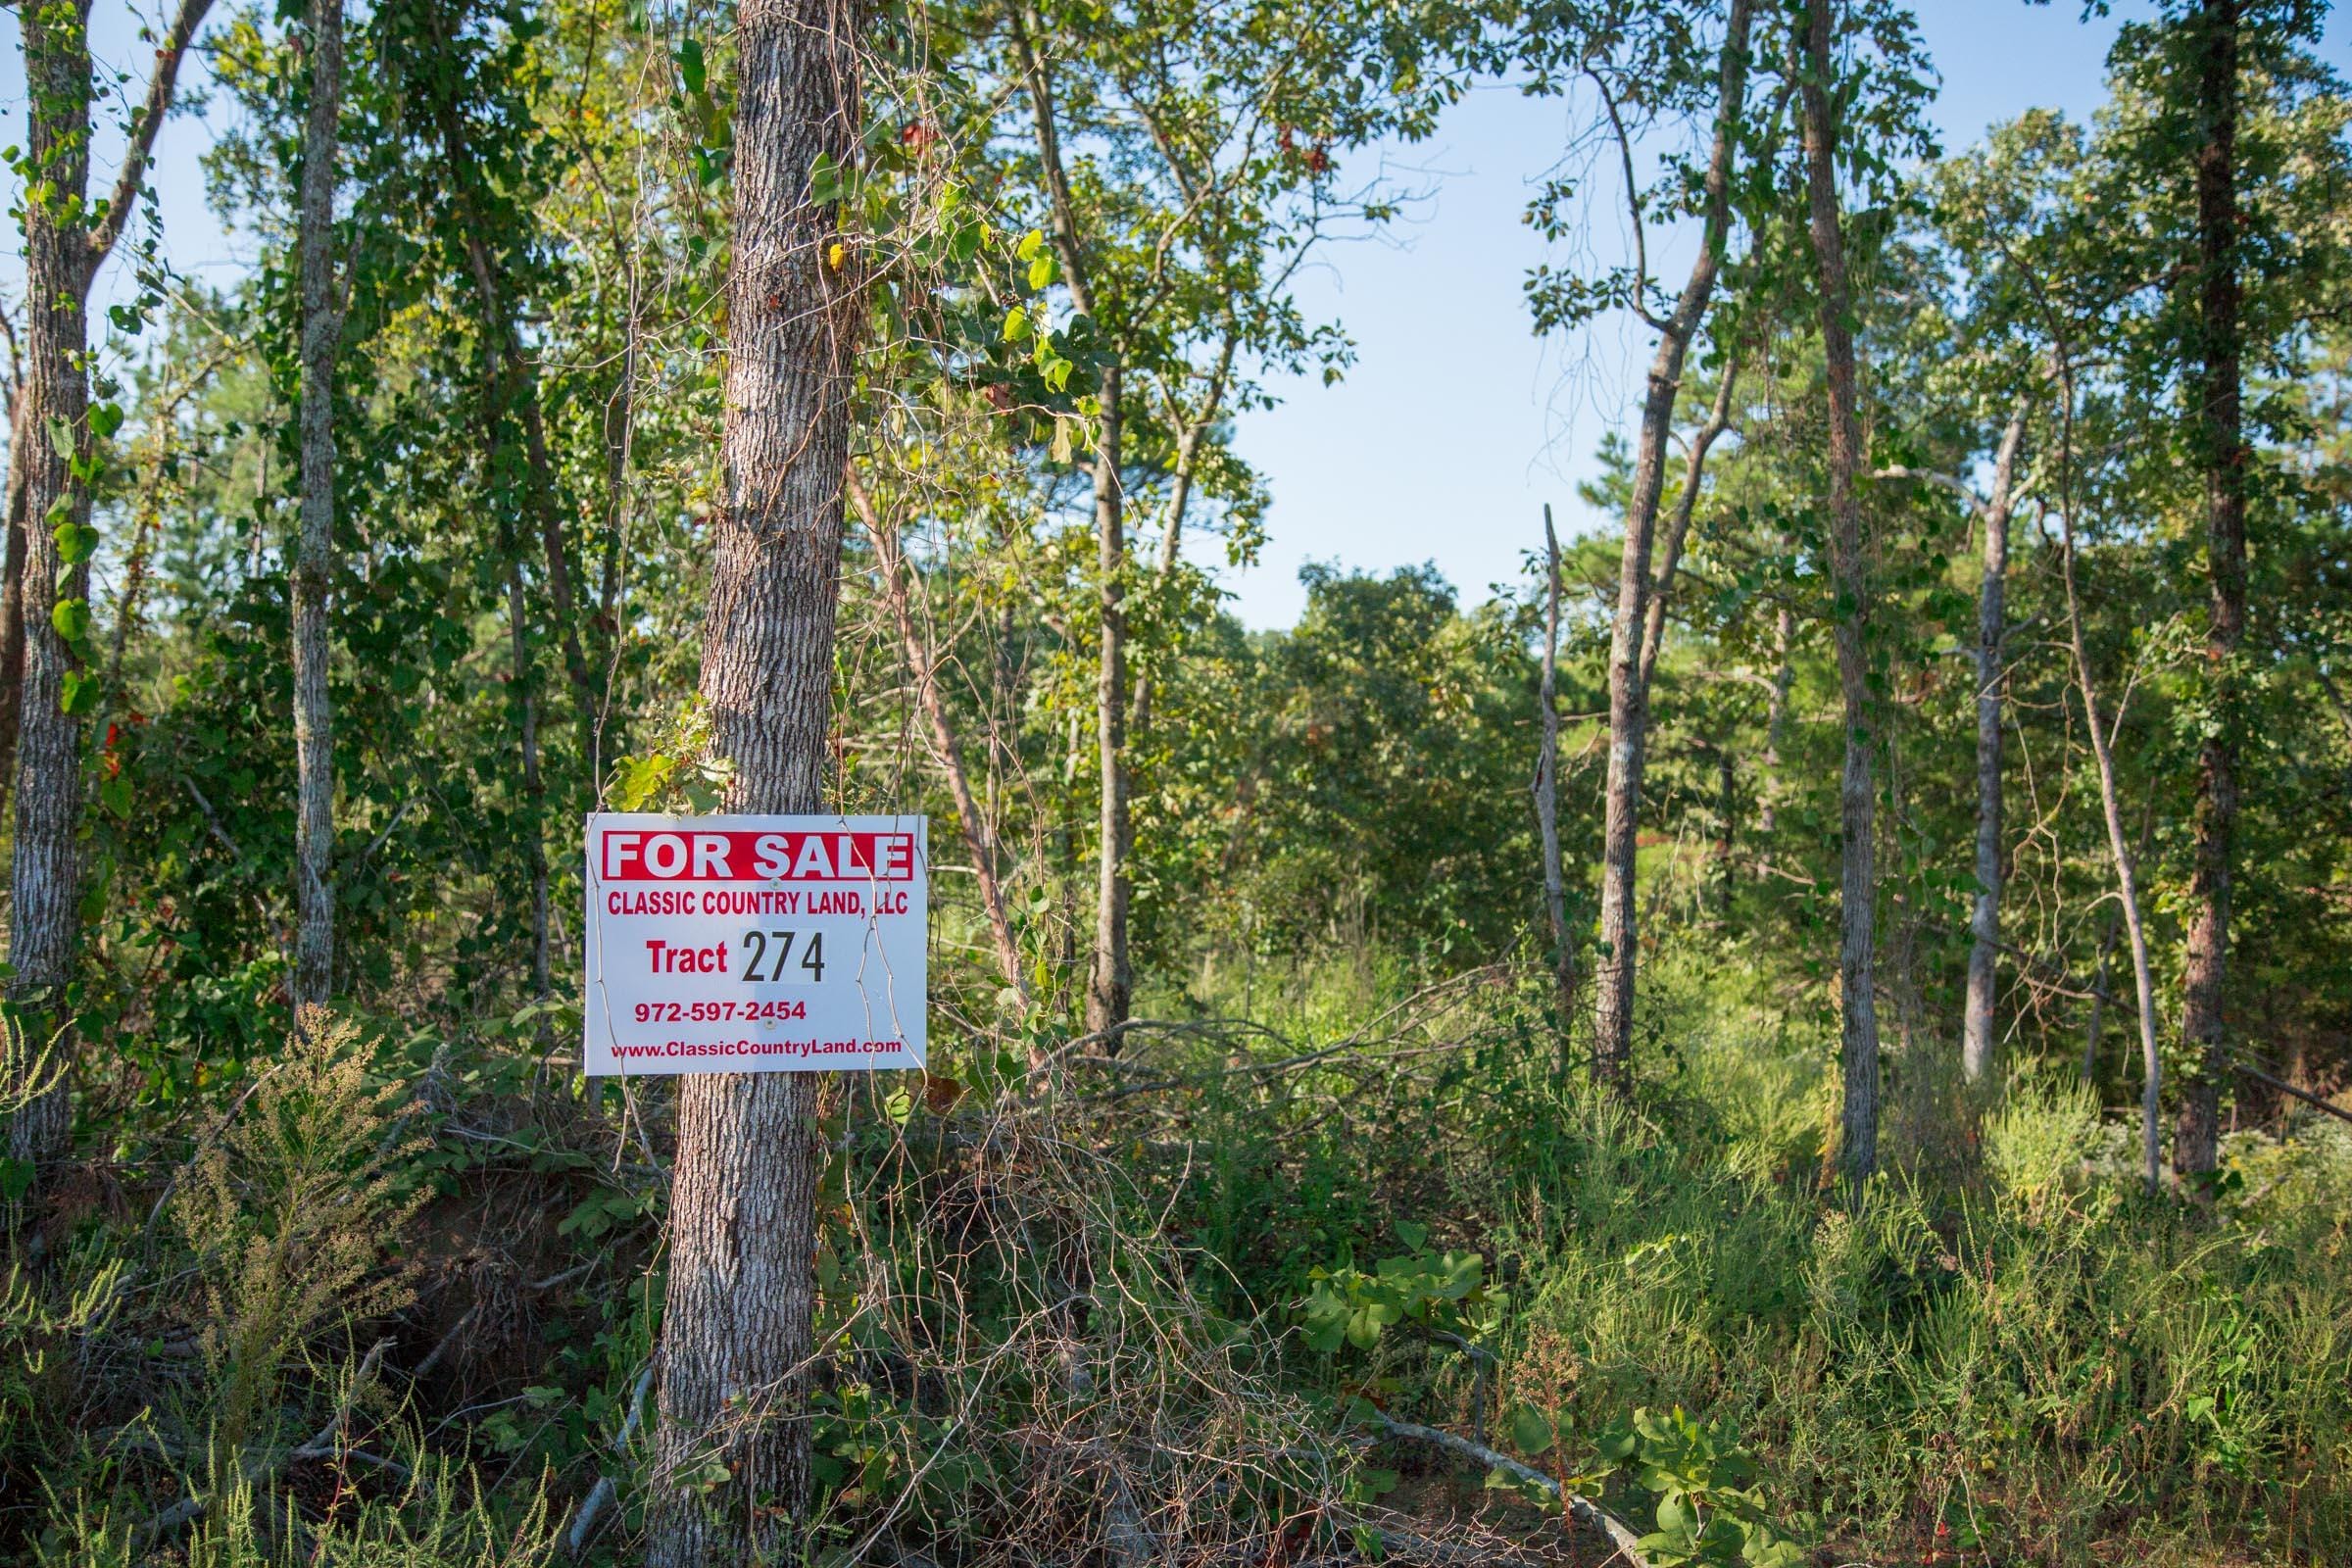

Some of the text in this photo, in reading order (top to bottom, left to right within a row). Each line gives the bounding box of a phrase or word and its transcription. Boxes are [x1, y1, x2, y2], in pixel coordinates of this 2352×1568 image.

[607, 834, 909, 879] FOR SALE
[608, 891, 908, 919] CLASSIC COUNTRY LAND, LLC
[646, 931, 825, 982] Tract 274
[634, 1001, 807, 1022] 972-597-2454
[611, 1039, 902, 1057] www.ClassicCountryLand.com
